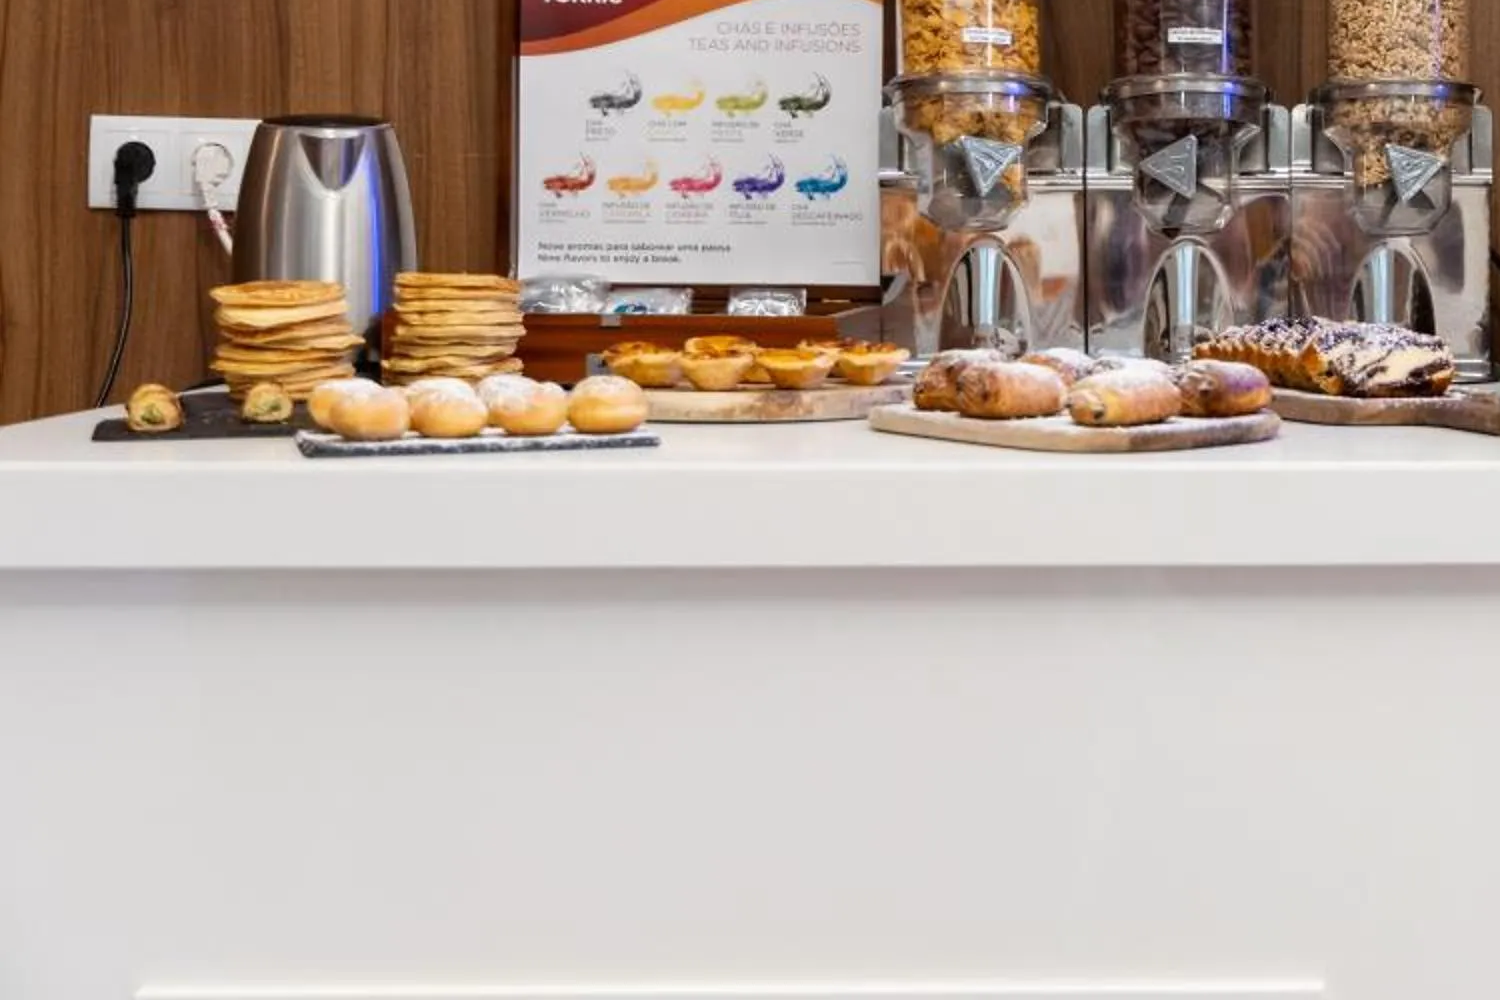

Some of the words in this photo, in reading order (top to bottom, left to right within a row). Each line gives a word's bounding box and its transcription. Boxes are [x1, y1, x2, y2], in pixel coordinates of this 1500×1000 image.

[766, 21, 778, 36] E
[689, 37, 730, 51] TEAS
[733, 37, 770, 52] AND
[774, 38, 863, 54] INFUSIONS
